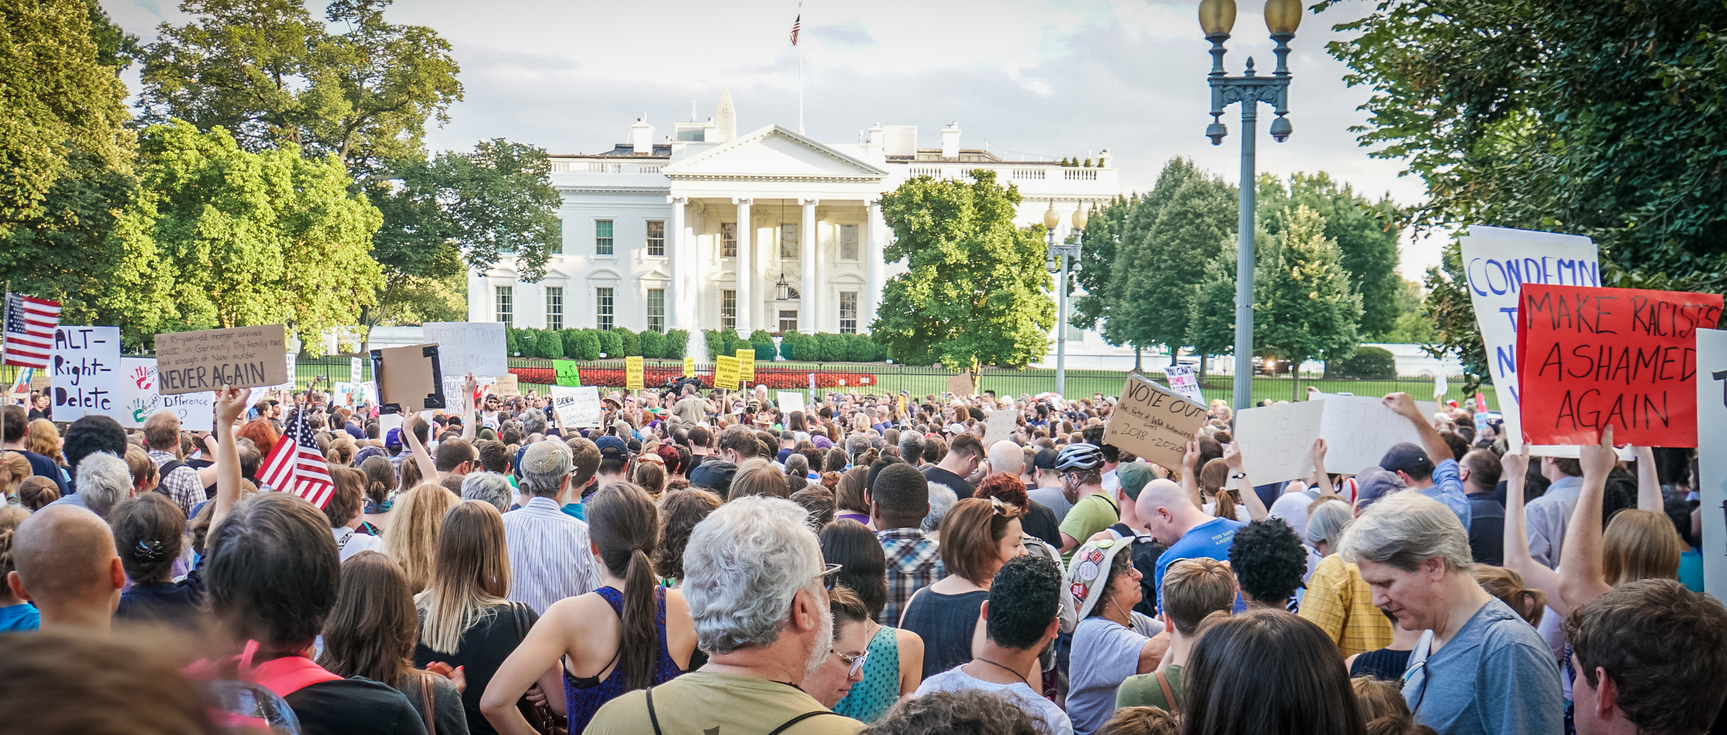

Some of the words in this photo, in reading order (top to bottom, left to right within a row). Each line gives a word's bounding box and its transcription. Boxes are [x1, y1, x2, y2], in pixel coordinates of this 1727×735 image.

[1469, 256, 1596, 296] CONDEMN
[1528, 292, 1617, 334] MAKE
[1630, 295, 1719, 338] RACISTS
[55, 329, 106, 349] ALT-
[156, 337, 166, 346] My
[170, 335, 208, 346] 85-year-old
[211, 332, 234, 340] mother
[234, 341, 245, 350] My
[247, 340, 268, 349] family
[431, 328, 468, 345] RESIST
[55, 355, 111, 386] Right-
[158, 358, 170, 367] had
[175, 356, 198, 366] enough
[442, 355, 466, 368] SAULT
[1539, 342, 1697, 384] ASHAMED
[158, 366, 208, 390] NEVER
[212, 362, 265, 387] AGAIN
[55, 387, 111, 410] Delete
[1120, 403, 1128, 412] The
[1129, 379, 1170, 407] VOTE
[1170, 400, 1205, 417] OUT
[1556, 389, 1668, 431] AGAIN
[1111, 427, 1117, 435] in
[1121, 423, 1148, 441] 2018
